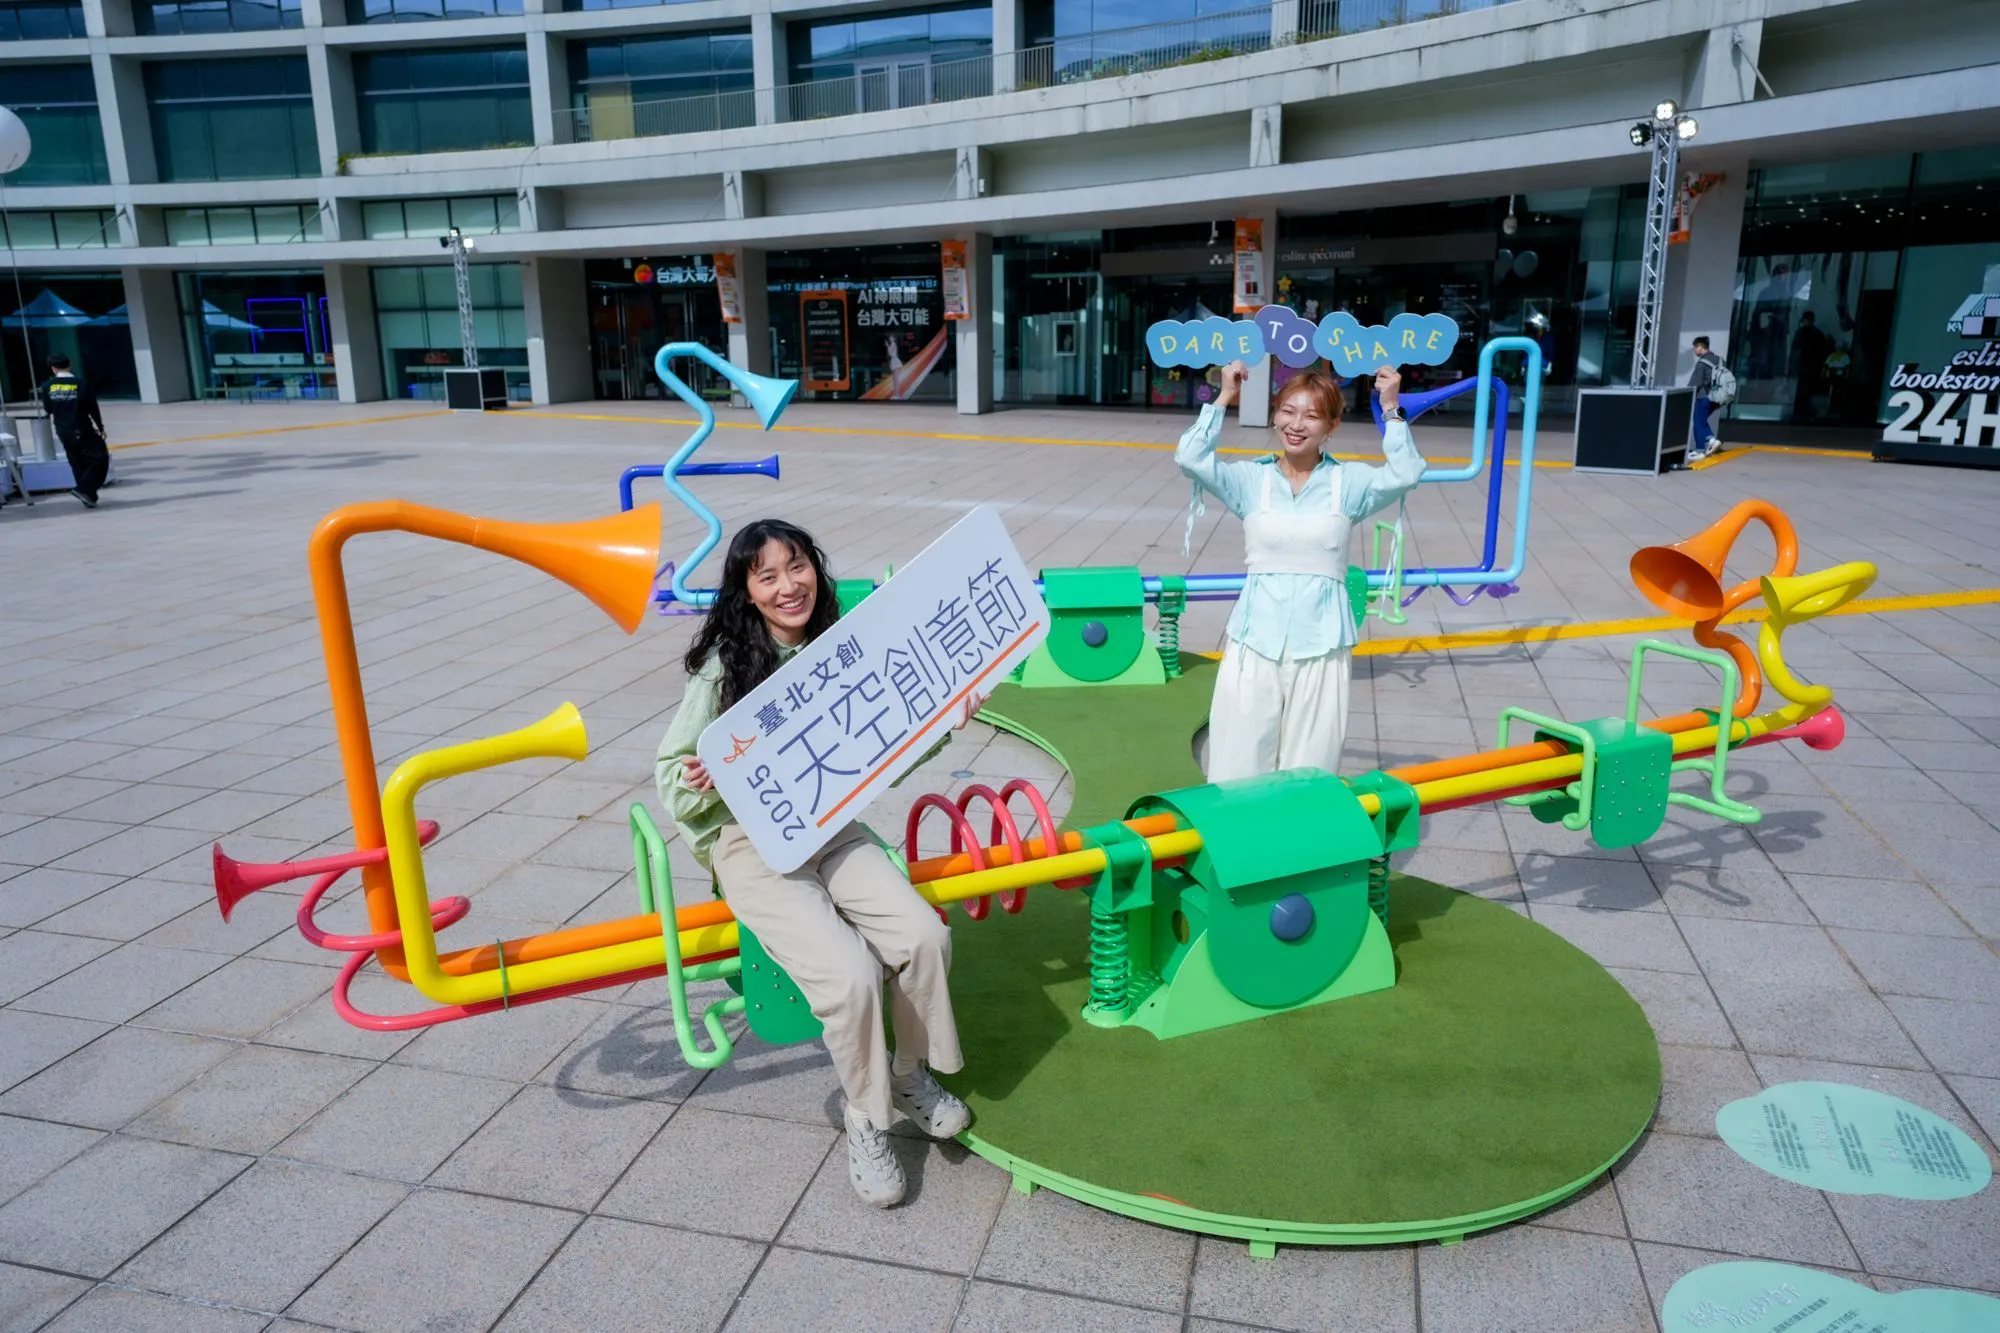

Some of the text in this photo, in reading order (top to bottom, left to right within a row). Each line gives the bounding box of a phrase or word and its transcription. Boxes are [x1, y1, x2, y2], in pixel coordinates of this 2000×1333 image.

[857, 307, 930, 327] 台灣大可能
[1160, 331, 1250, 355] DARE
[1269, 321, 1308, 354] TO
[1328, 327, 1443, 363] SHARE
[754, 634, 864, 737] 臺北文創
[777, 557, 1027, 815] 天空創意節
[746, 764, 806, 841] 2025
